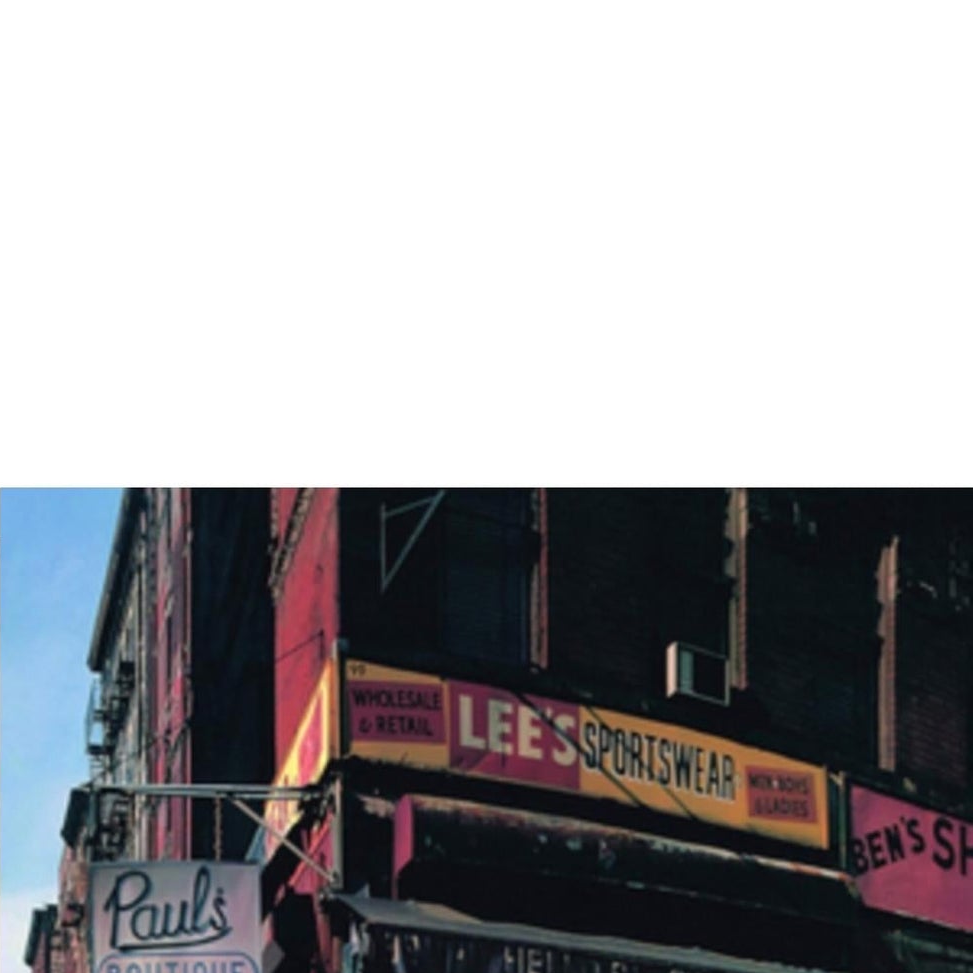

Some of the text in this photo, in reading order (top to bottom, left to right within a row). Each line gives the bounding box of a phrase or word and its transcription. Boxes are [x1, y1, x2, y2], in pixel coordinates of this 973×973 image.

[352, 689, 442, 712] WHOLESALE
[377, 715, 434, 737] RETAIL
[458, 695, 736, 802] LEE'S SPORTSWEAR
[851, 816, 925, 876] BEN'S
[104, 866, 233, 952] Paul's
